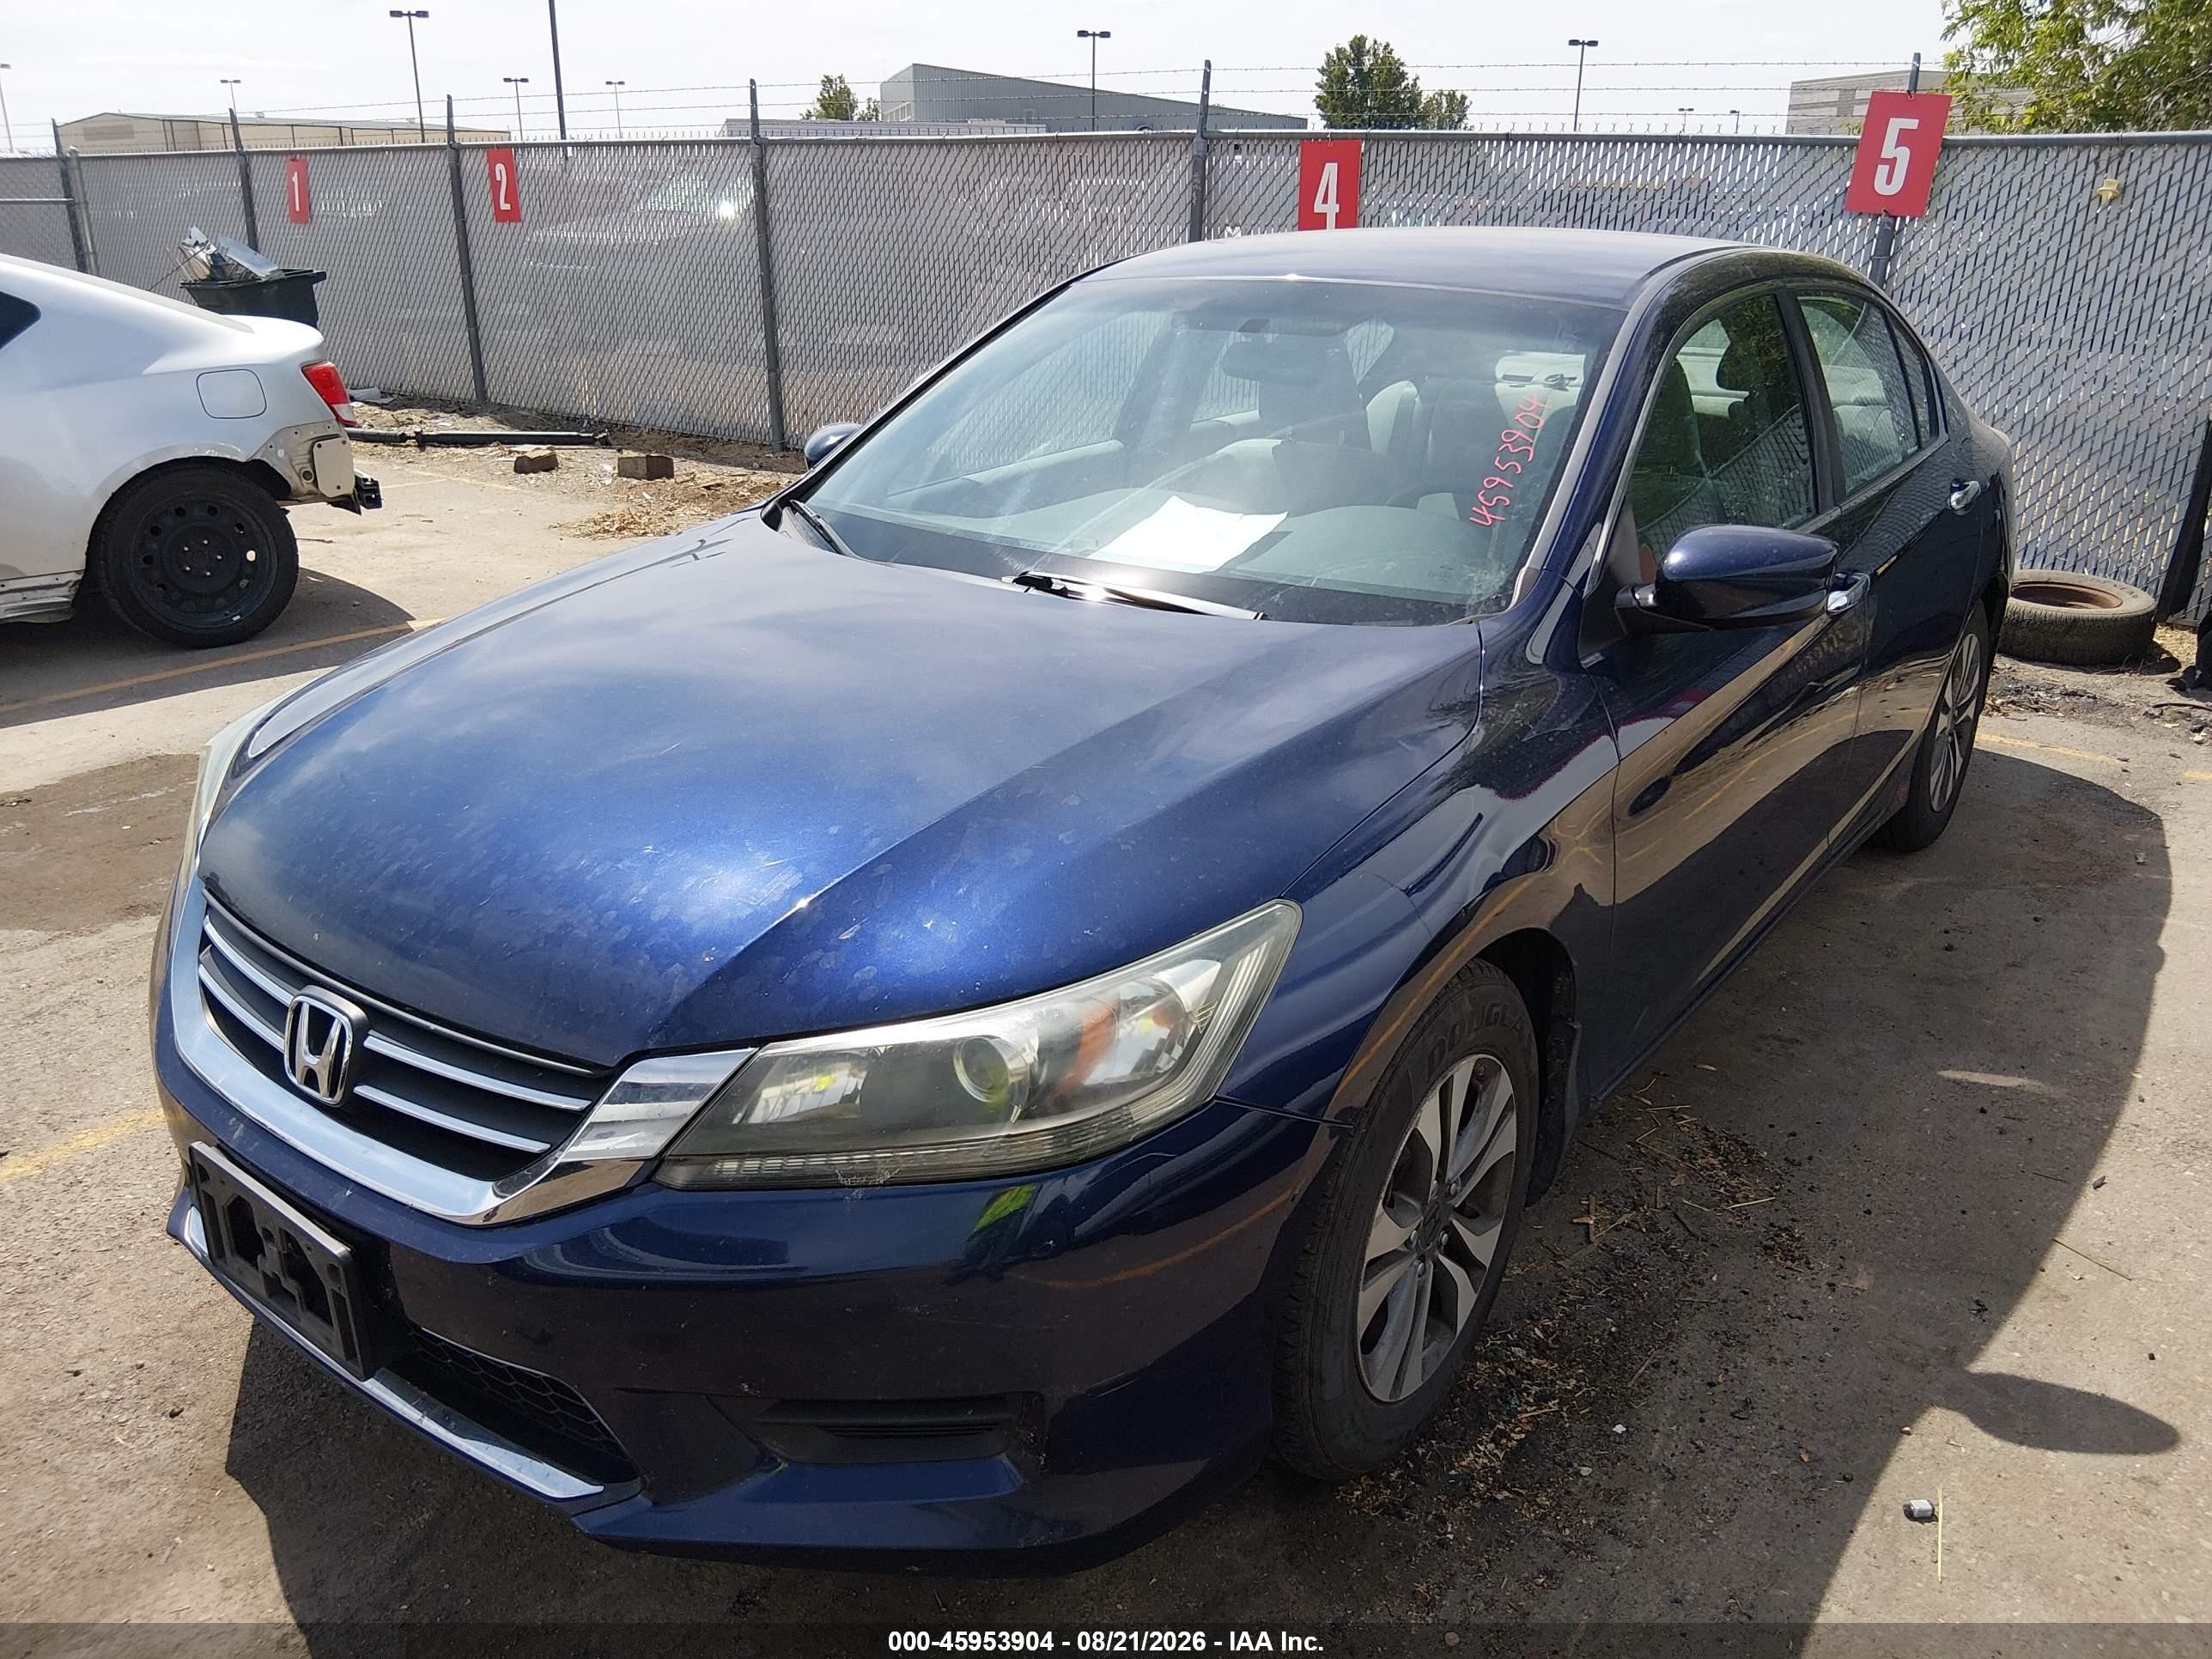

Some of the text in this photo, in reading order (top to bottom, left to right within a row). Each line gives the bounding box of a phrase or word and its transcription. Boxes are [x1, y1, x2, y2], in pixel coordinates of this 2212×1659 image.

[495, 163, 511, 210] 2
[1874, 117, 1920, 196] 5
[292, 171, 300, 212] 1
[1314, 162, 1340, 231] 4
[1469, 396, 1553, 527] 45953904
